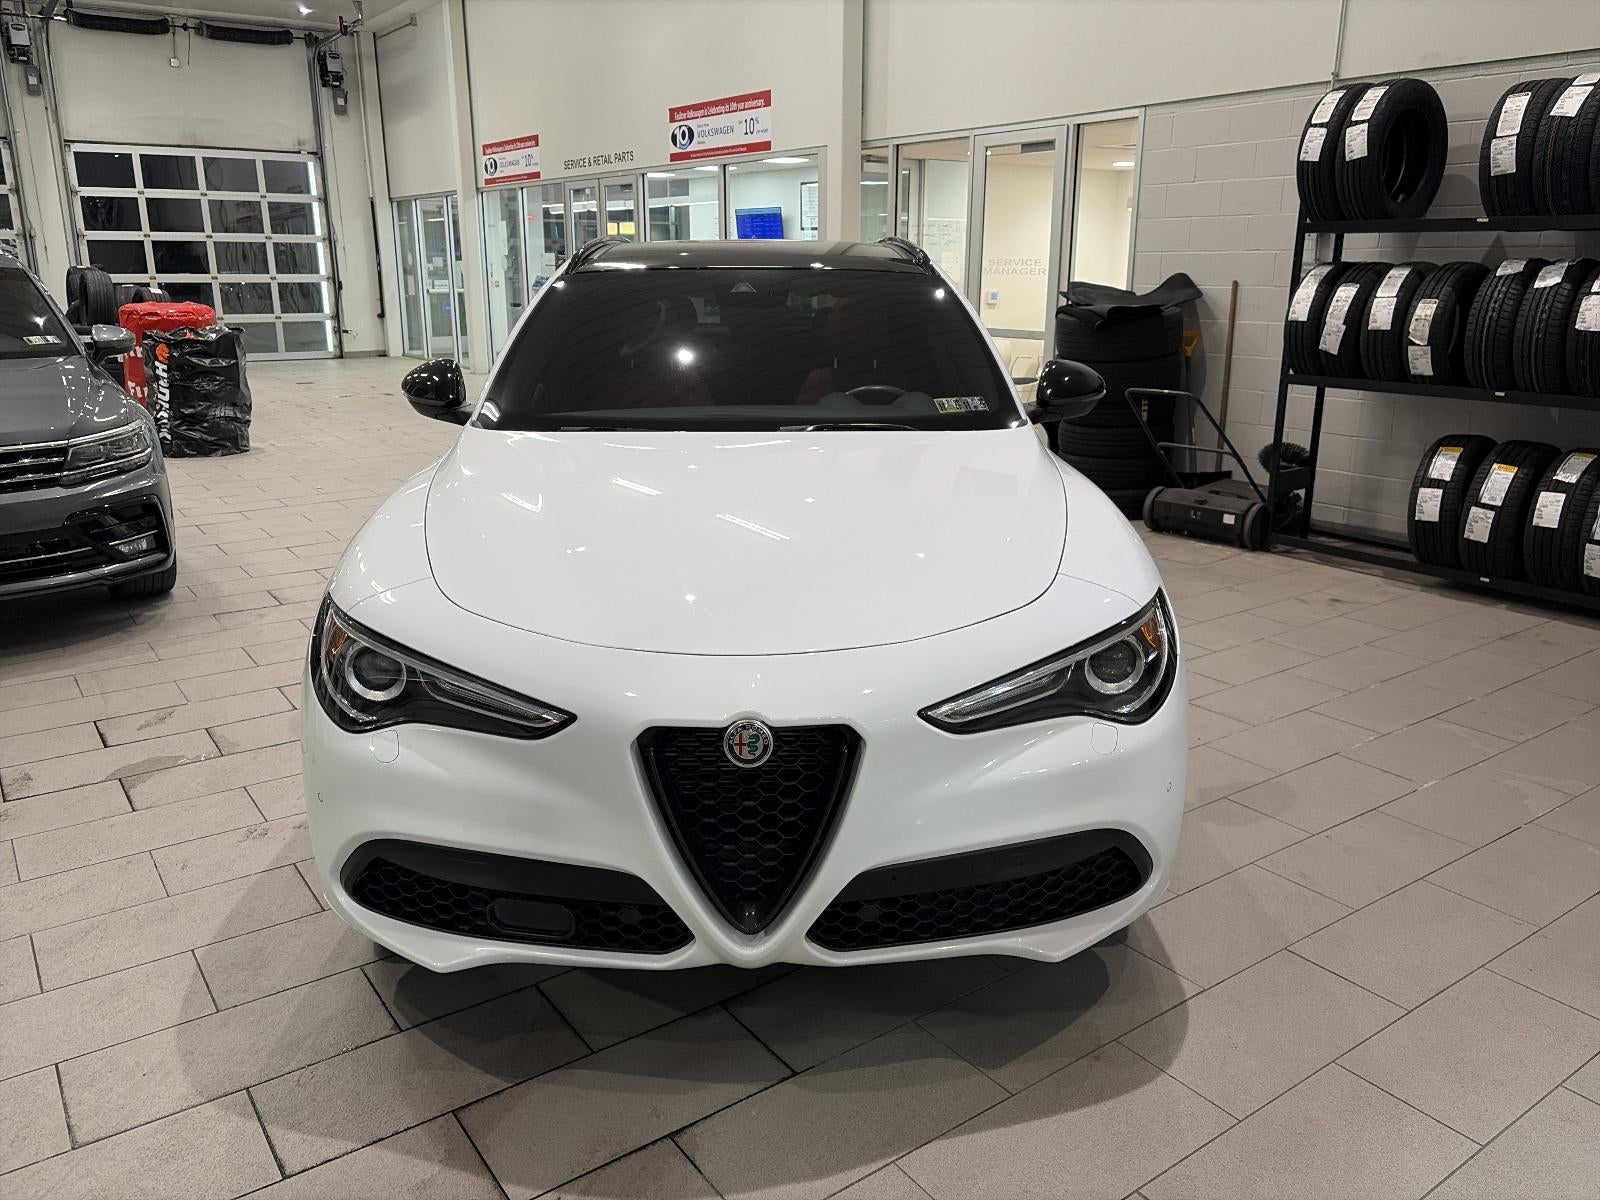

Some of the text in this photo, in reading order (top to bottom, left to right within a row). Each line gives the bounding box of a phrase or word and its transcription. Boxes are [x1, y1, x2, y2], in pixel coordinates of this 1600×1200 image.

[697, 124, 735, 138] VOLKSWAGEN
[563, 150, 634, 170] SERVICE & RETAIL PARTS
[988, 258, 1042, 267] SERVICE
[984, 267, 1047, 276] MANAGER
[729, 724, 769, 745] ALFA ROMEO
